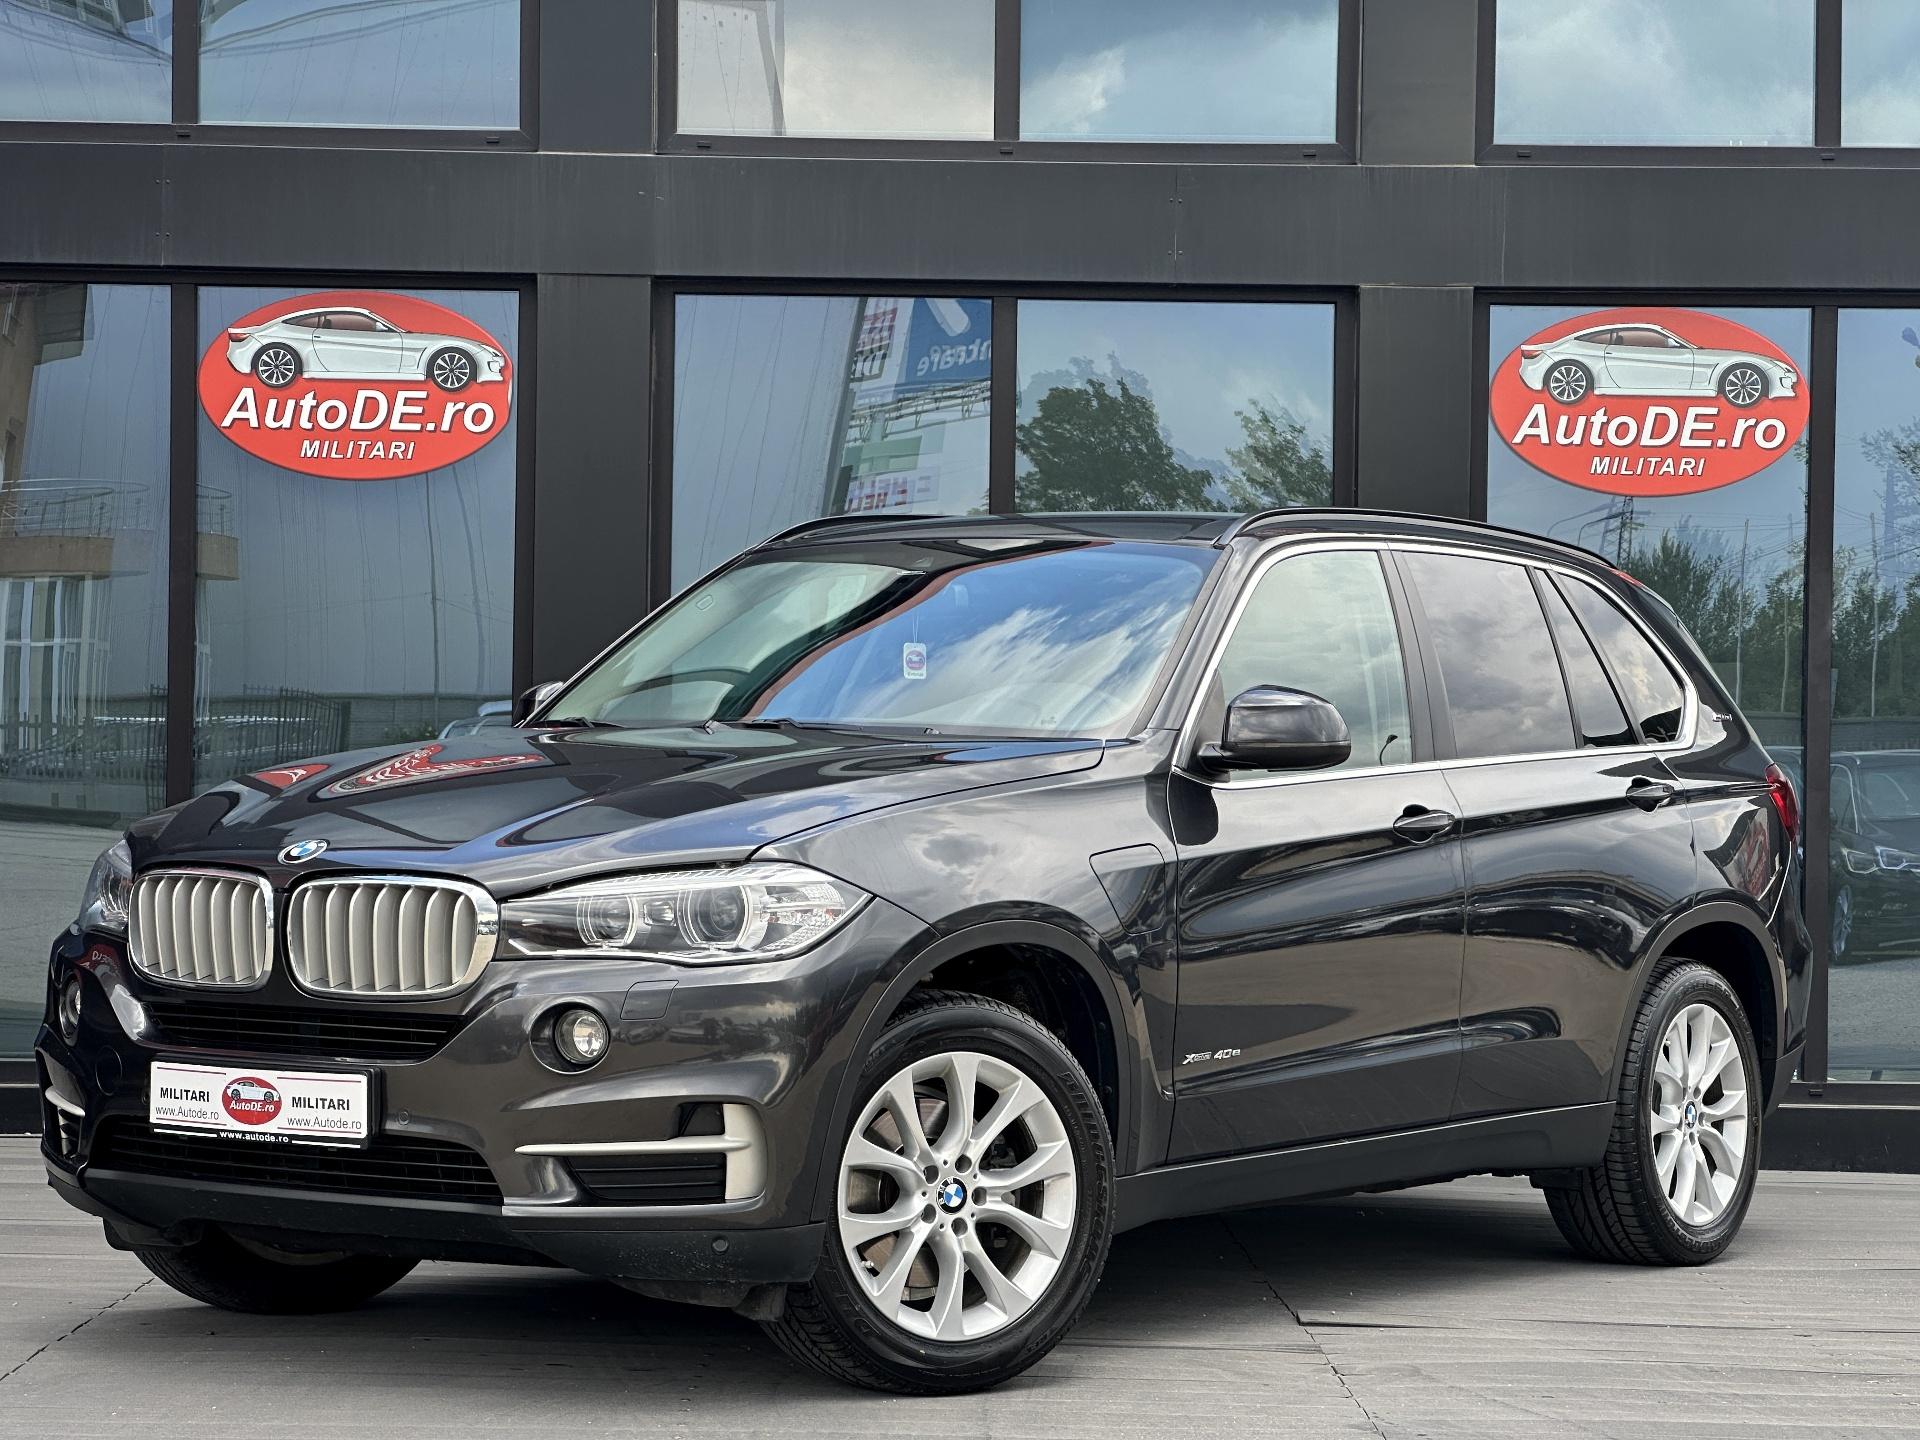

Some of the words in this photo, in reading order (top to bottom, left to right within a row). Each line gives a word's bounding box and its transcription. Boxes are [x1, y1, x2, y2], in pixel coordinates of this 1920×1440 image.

[221, 387, 496, 432] AutoDE.ro
[1511, 403, 1786, 449] AutoDE.ro
[300, 440, 415, 460] MILITARI
[1590, 456, 1706, 476] MILITARI
[160, 1087, 210, 1102] MILITARI
[229, 1101, 275, 1112] AutoDE.ro
[291, 1096, 350, 1111] MILITARI
[155, 1105, 219, 1120] www.Autode.ro
[287, 1116, 362, 1130] www.Autode.ro
[219, 1130, 289, 1143] www.autode.ro
